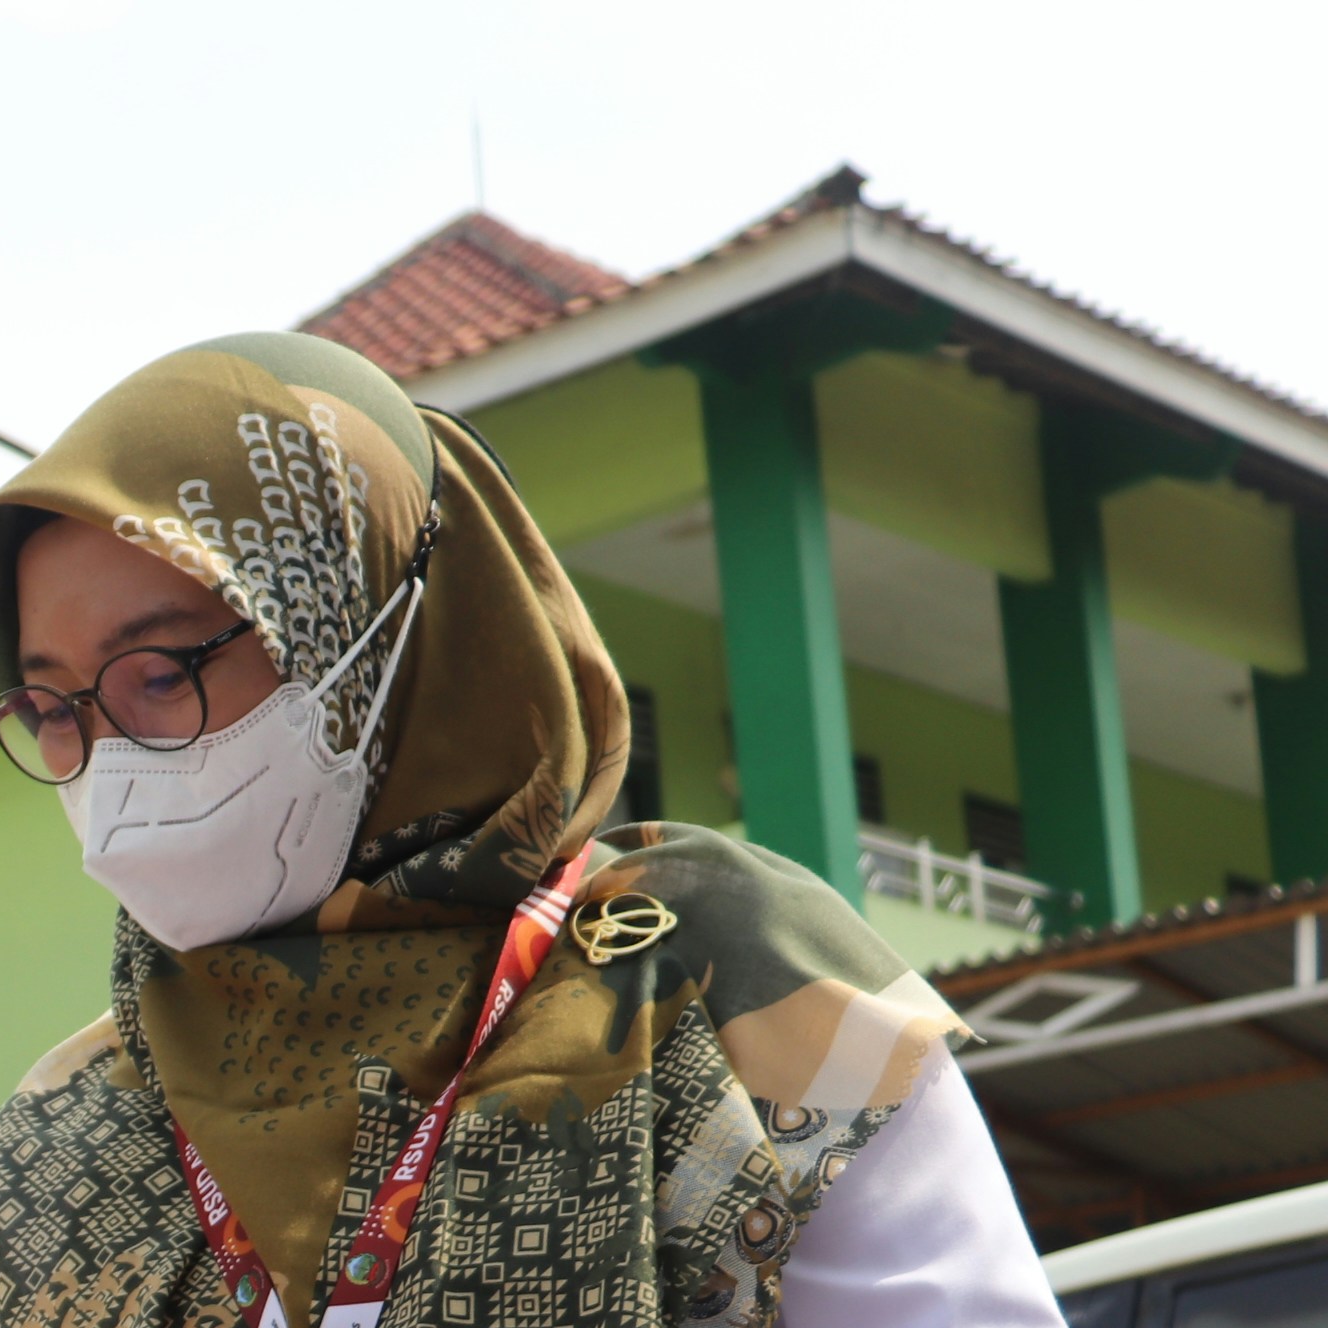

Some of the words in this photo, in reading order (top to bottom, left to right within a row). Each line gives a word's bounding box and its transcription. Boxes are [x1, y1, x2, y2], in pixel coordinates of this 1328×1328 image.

[477, 978, 515, 1047] RSUD
[392, 1113, 437, 1181] RSUD
[195, 1167, 229, 1227] RSUD
